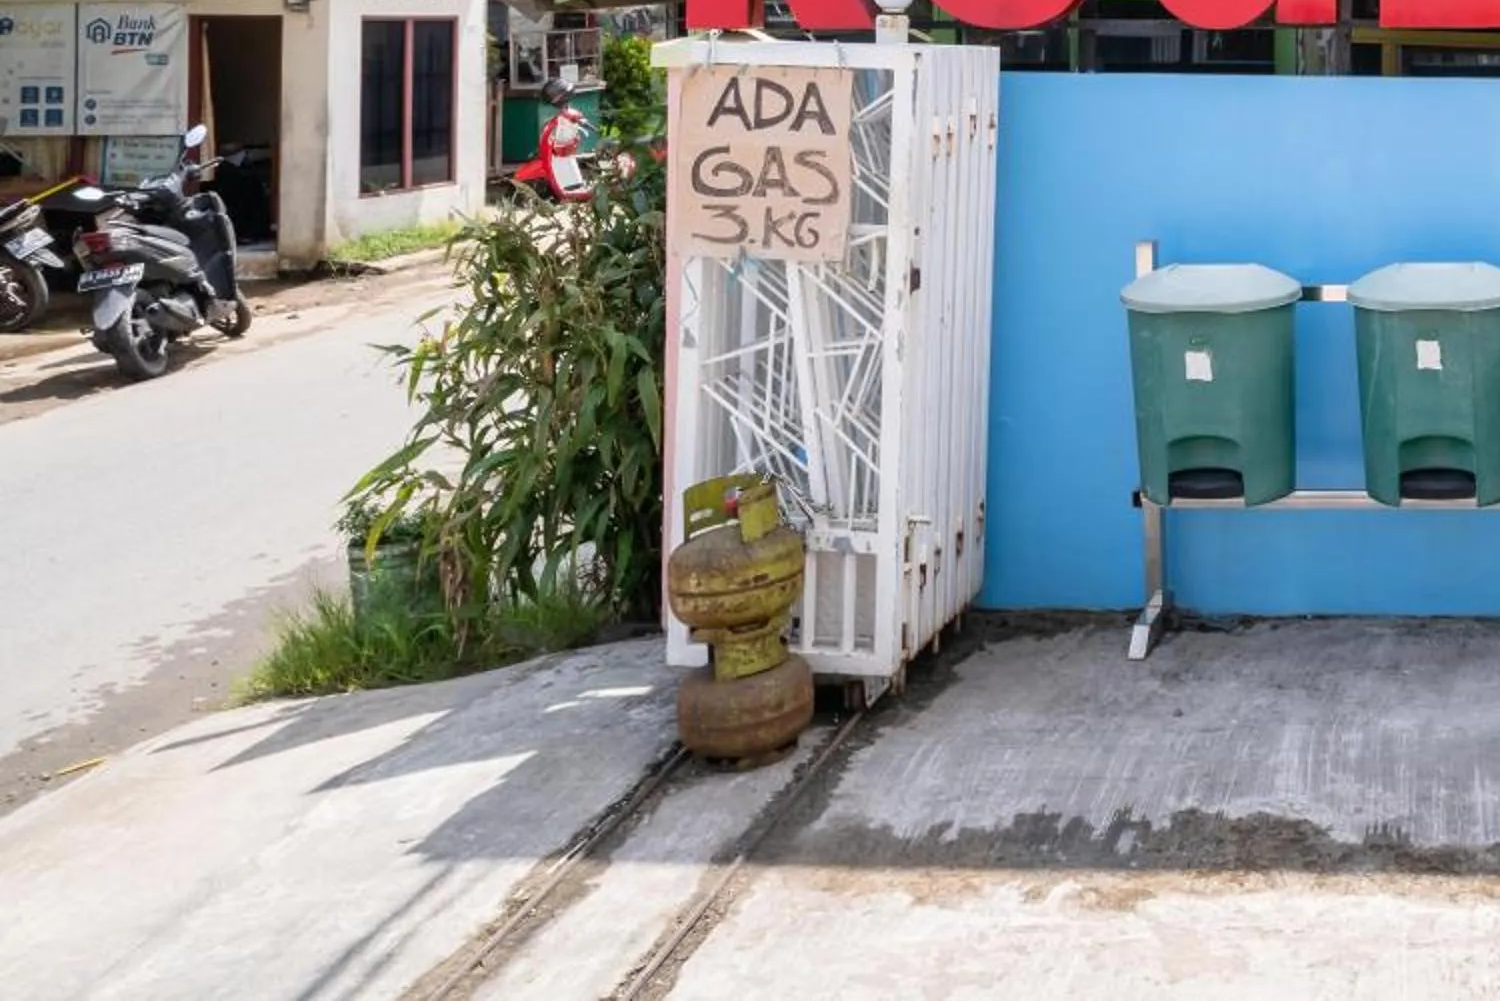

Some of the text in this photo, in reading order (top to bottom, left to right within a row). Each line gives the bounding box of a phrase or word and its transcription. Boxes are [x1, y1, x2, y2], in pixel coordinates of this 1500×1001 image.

[113, 32, 154, 46] BTN
[706, 76, 836, 135] ADA
[691, 145, 840, 205] GAS
